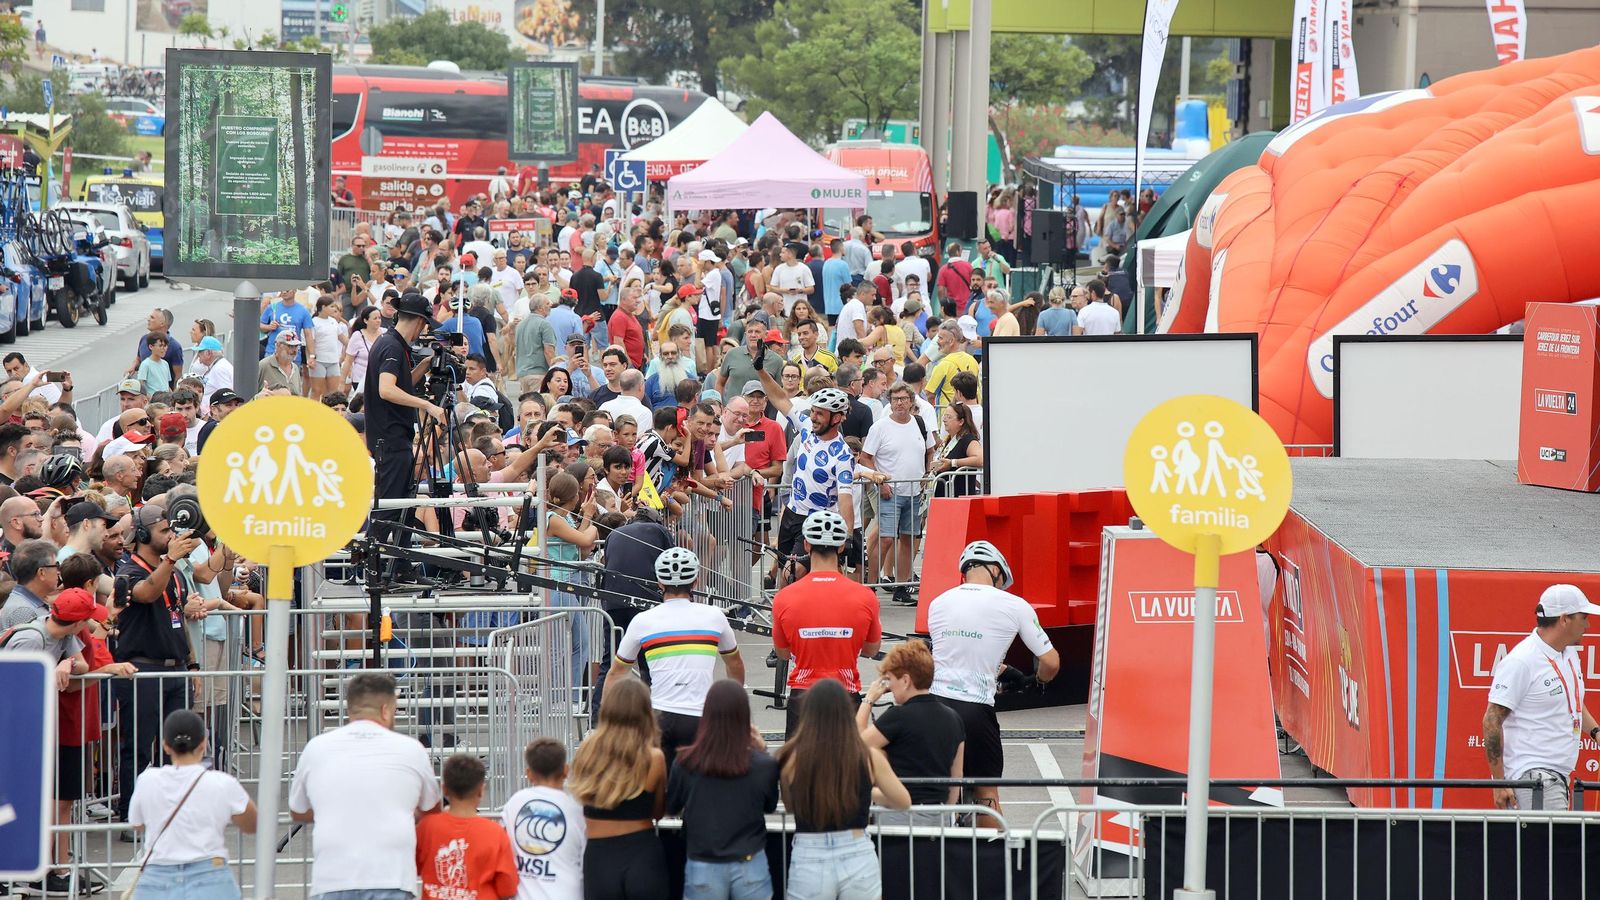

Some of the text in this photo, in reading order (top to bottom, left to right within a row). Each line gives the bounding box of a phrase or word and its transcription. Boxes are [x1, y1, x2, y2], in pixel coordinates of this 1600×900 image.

[383, 107, 424, 118] Bianchi
[577, 107, 615, 135] EA
[627, 116, 663, 137] B&B
[372, 163, 415, 173] gasolinera
[877, 168, 909, 178] OFICIAL
[380, 180, 414, 192] salida
[822, 188, 862, 199] MUJER
[1560, 333, 1572, 343] JEREZ
[1537, 342, 1580, 355] JEREZ DE LA FRONTERA
[1537, 393, 1575, 410] LA VUELTA 24
[1169, 503, 1250, 529] familia
[243, 513, 326, 538] familia
[1140, 596, 1233, 617] LA VUETA
[941, 628, 983, 640] plenitude
[516, 855, 556, 878] WSL
